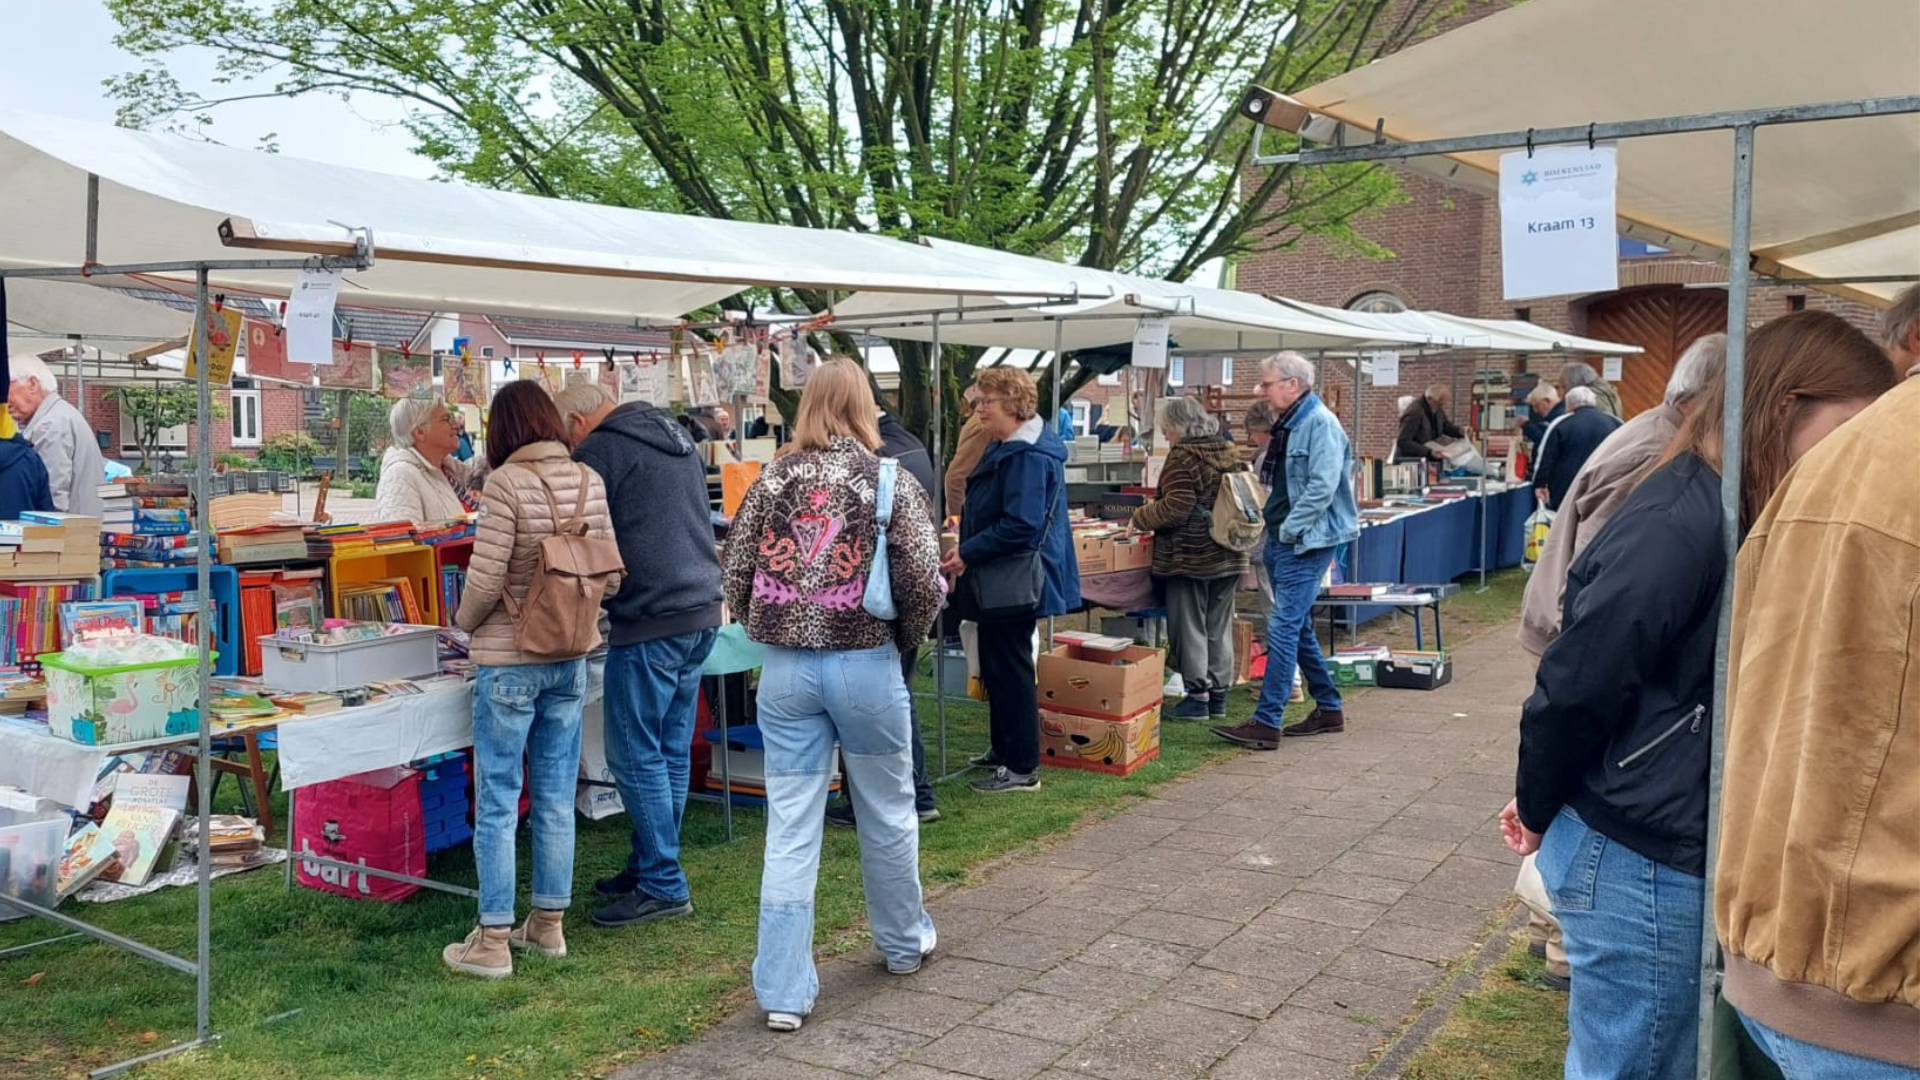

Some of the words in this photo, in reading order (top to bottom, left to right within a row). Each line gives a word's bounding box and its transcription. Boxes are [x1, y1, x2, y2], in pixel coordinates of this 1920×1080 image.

[1544, 163, 1602, 176] BOEKENSTAD
[1527, 219, 1575, 234] Kraam
[1580, 216, 1595, 230] 13
[766, 463, 816, 495] BLIND
[821, 463, 850, 484] FOR
[849, 473, 876, 504] LOVE
[130, 786, 174, 797] GROTE
[302, 837, 371, 894] bart
